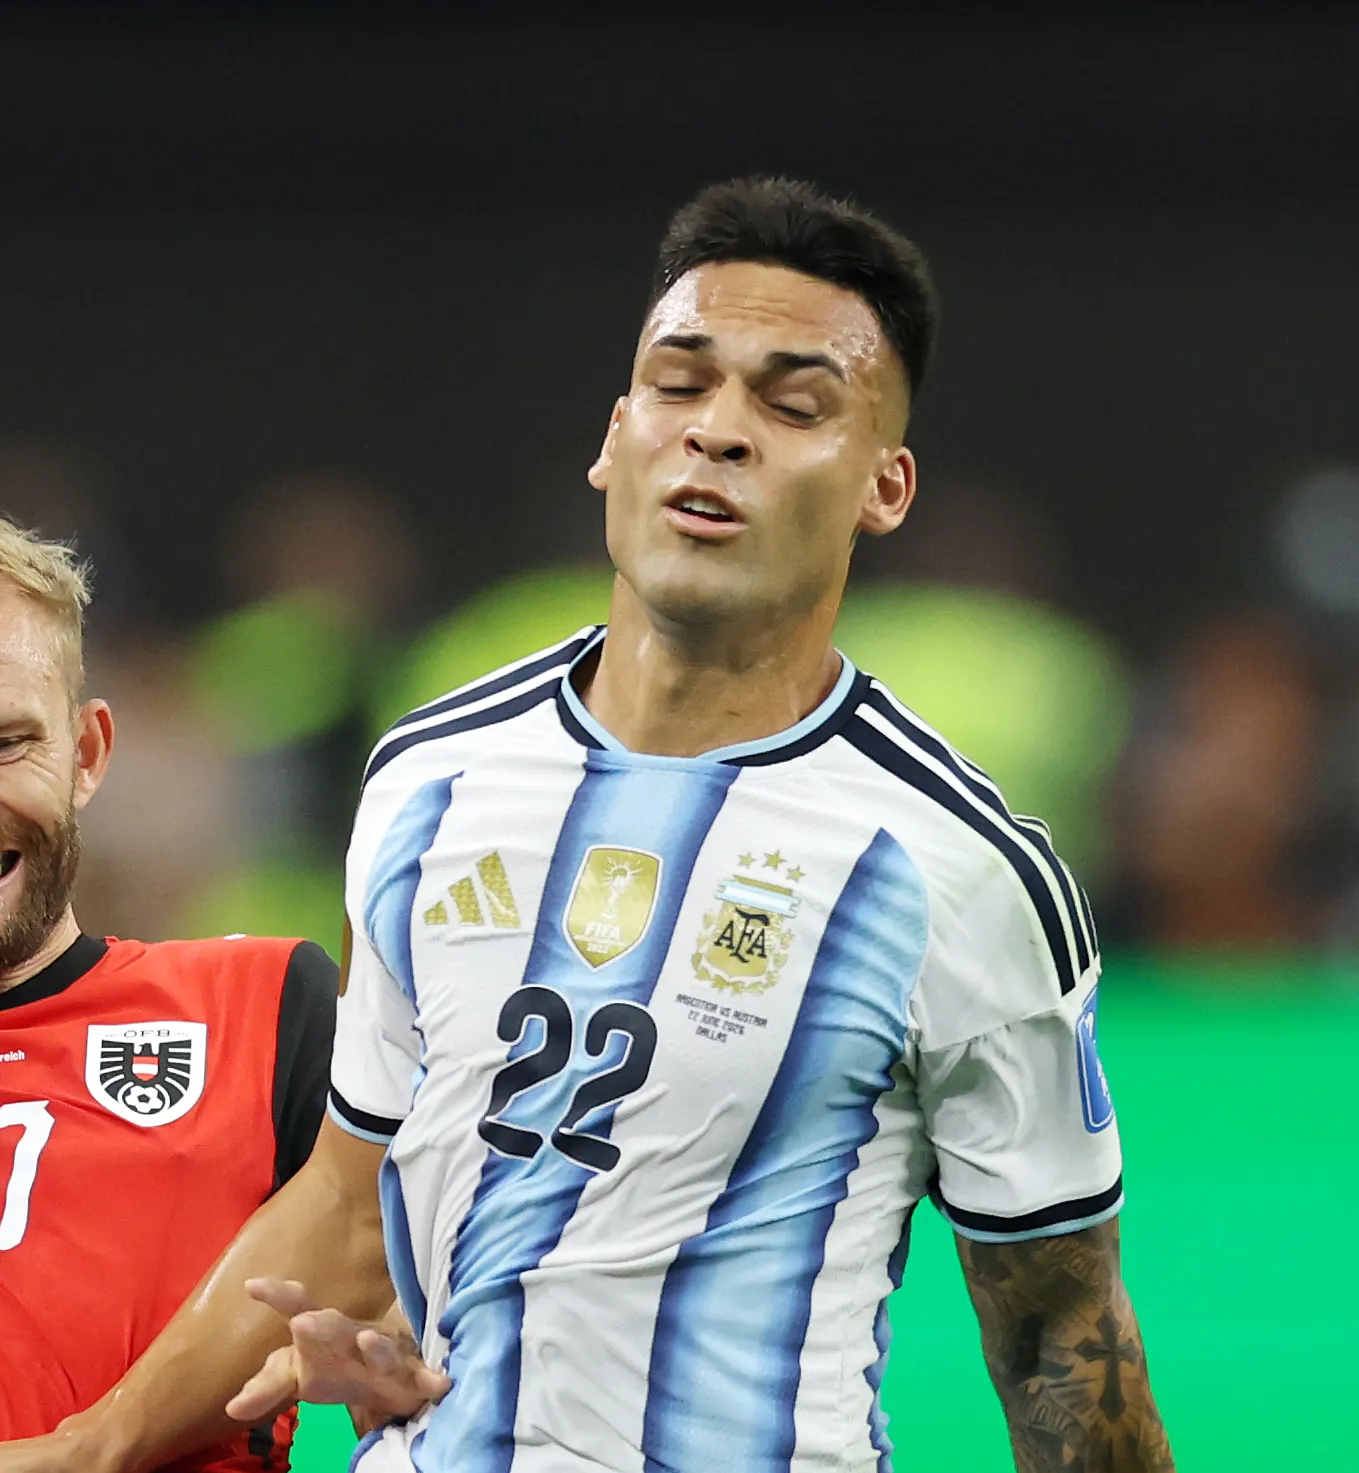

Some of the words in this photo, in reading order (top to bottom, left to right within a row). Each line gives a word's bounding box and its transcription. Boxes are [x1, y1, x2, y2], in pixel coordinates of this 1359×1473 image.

[584, 921, 621, 940] FIFA
[713, 907, 770, 963] AFA
[476, 985, 659, 1173] 22
